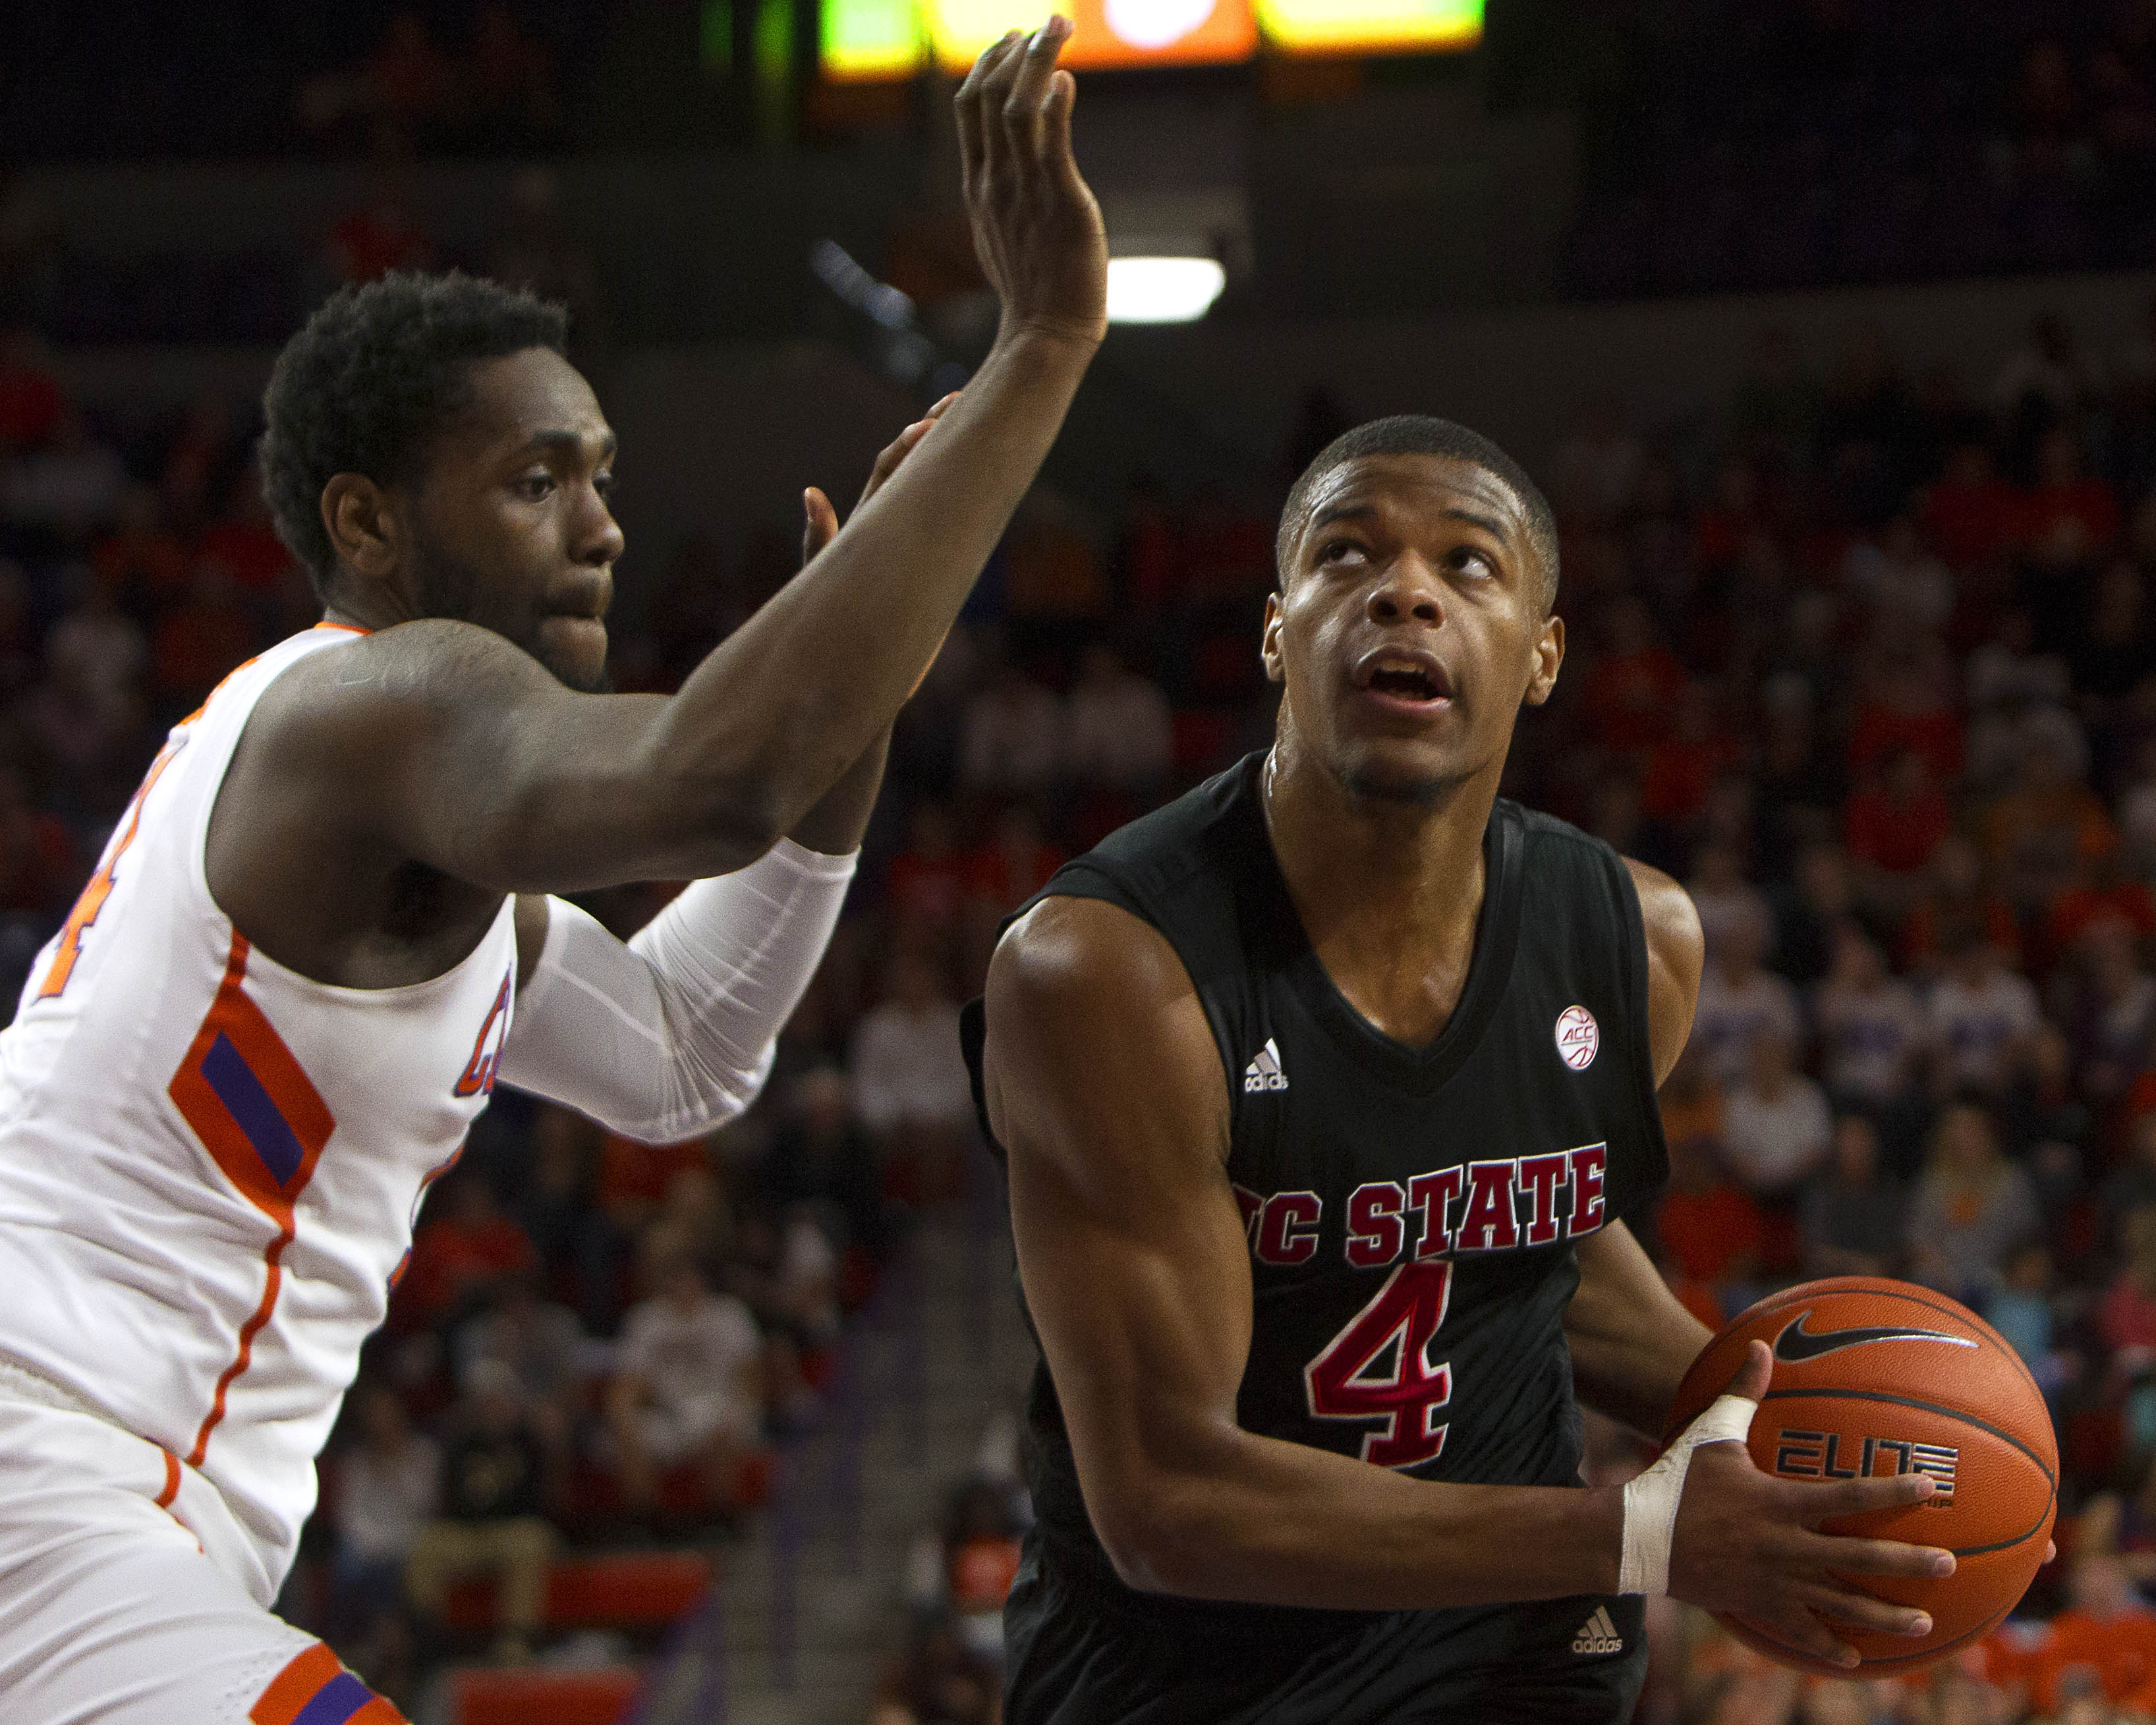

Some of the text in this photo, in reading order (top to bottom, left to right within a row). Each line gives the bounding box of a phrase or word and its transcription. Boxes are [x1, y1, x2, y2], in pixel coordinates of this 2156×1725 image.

[1562, 1026, 1593, 1042] ACC
[1245, 1071, 1289, 1092] adids
[1345, 1142, 1606, 1268] STATE
[1304, 1258, 1454, 1469] 4
[1776, 1428, 1958, 1496] ELITE
[1572, 1637, 1622, 1653] adidas
